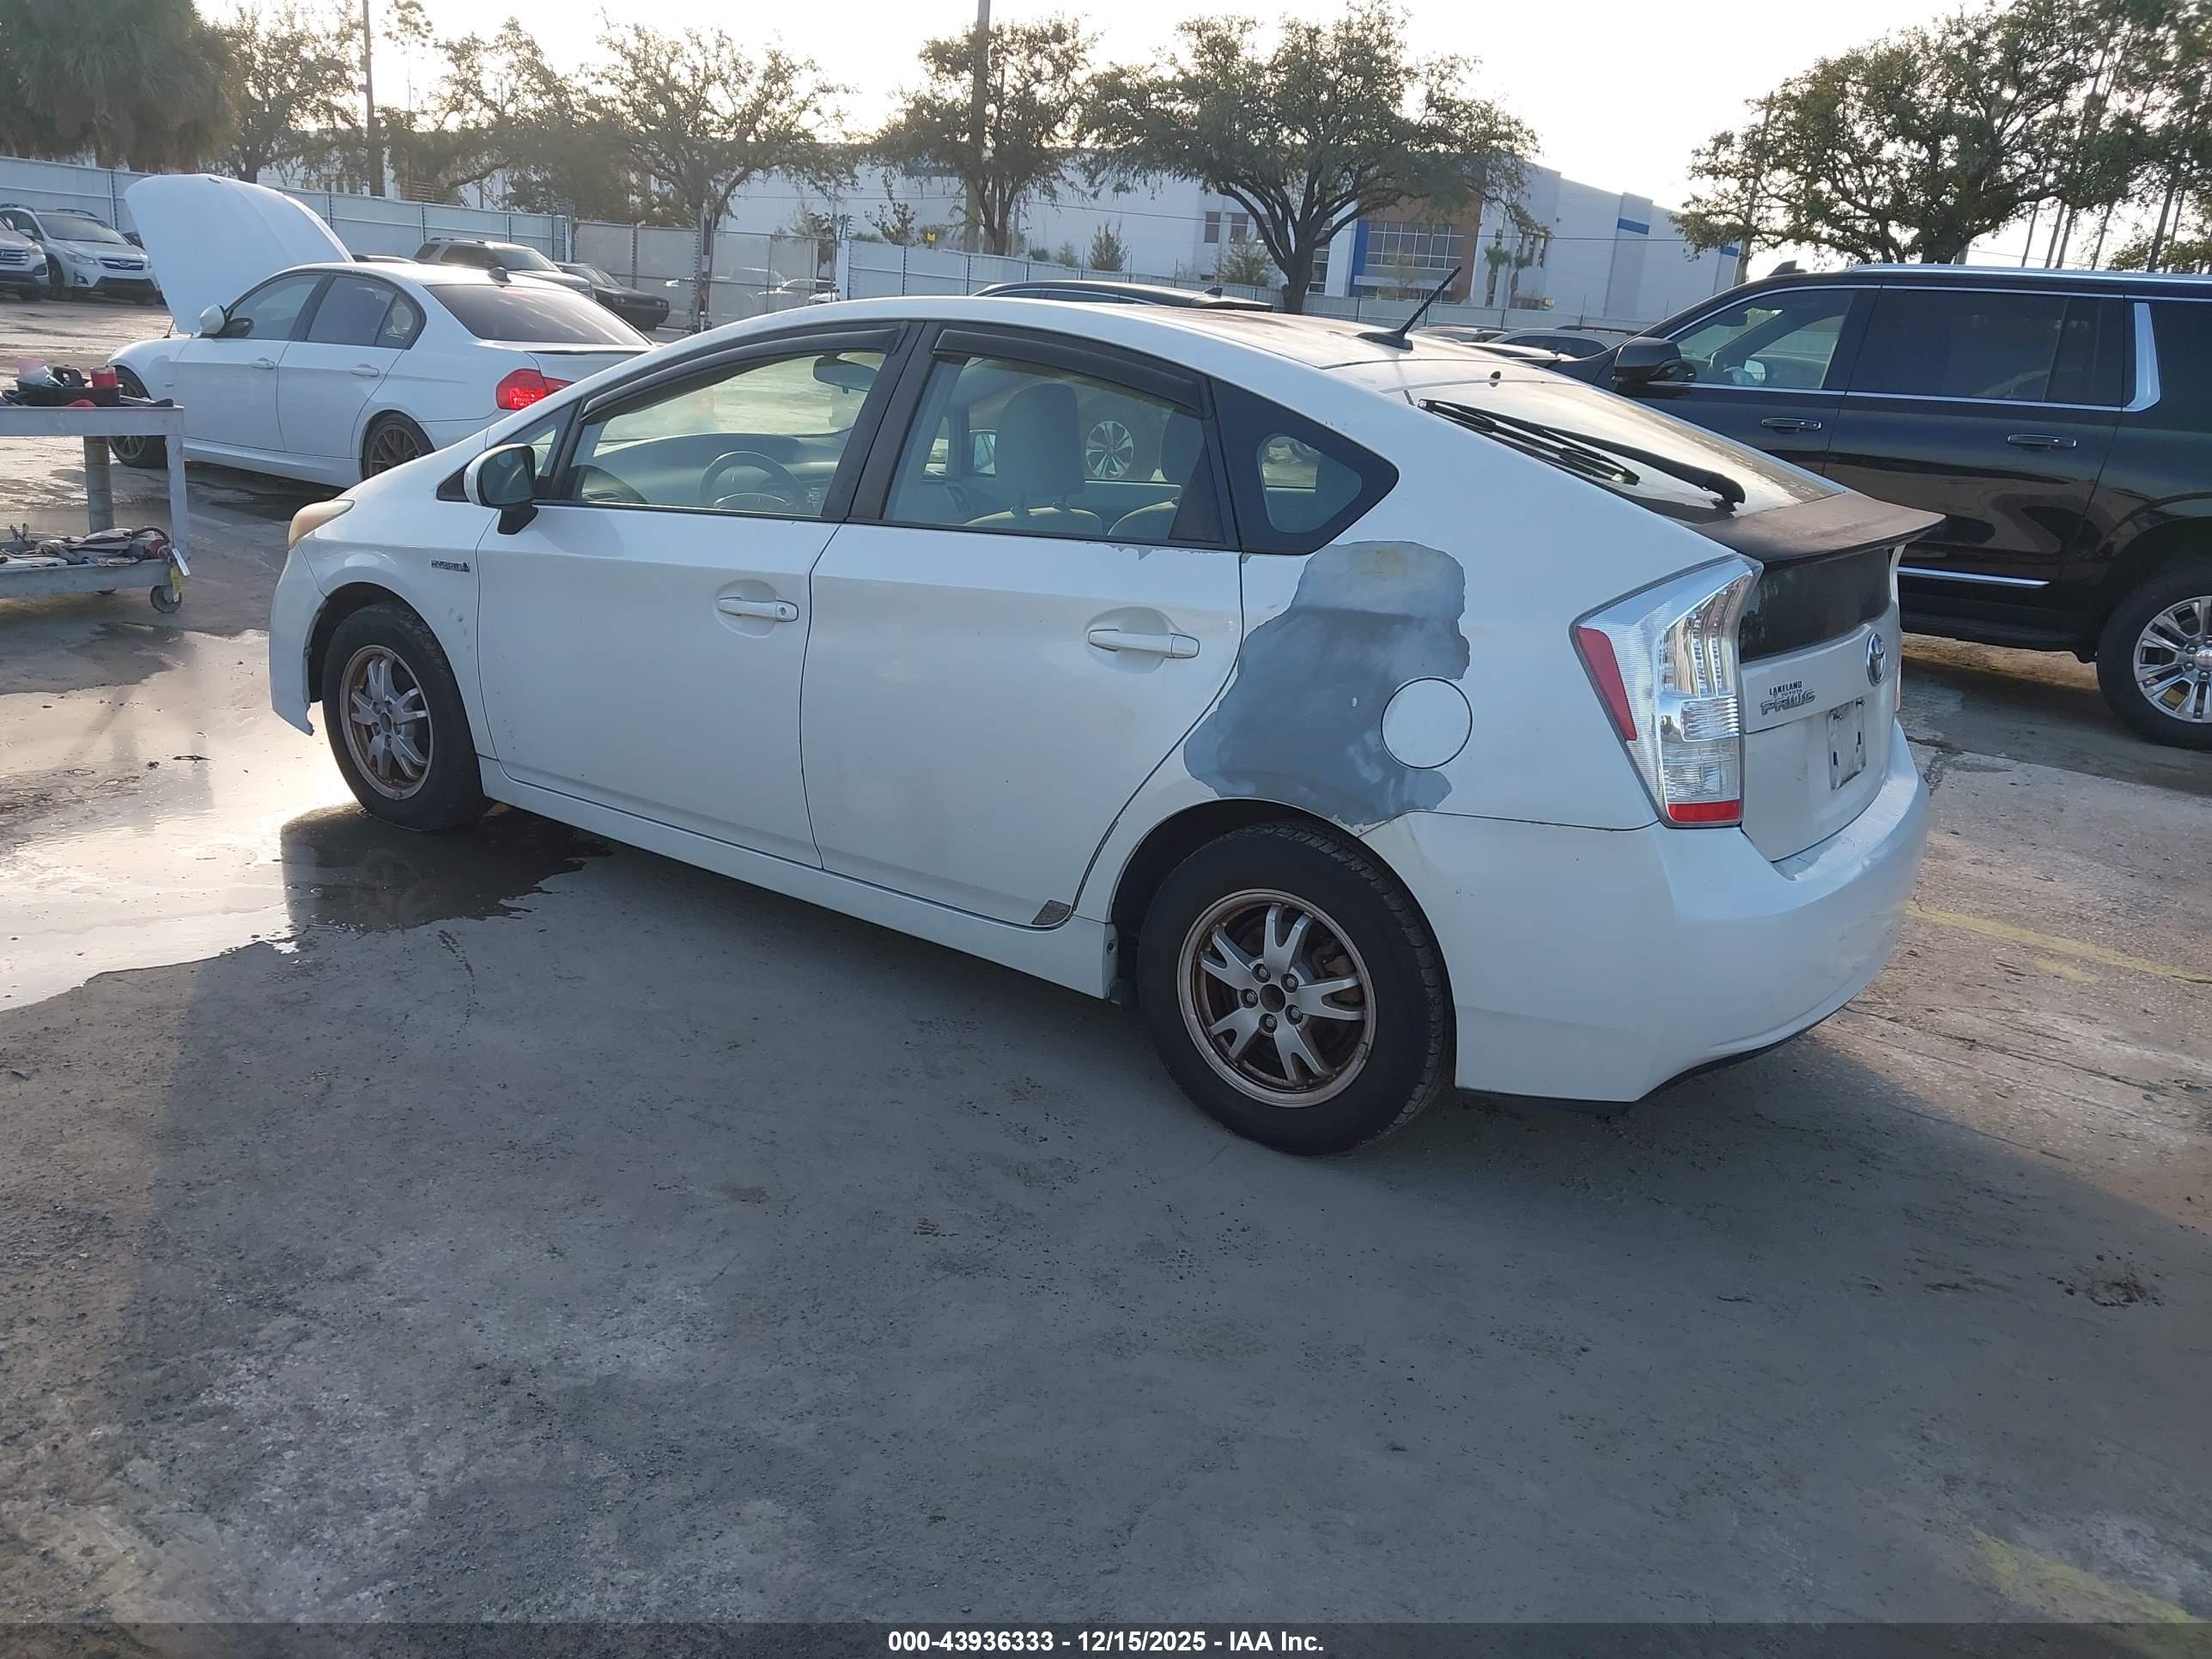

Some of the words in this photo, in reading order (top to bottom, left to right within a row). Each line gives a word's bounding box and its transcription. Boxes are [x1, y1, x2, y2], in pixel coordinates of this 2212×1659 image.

[431, 559, 463, 572] HYBRID
[1769, 680, 1802, 696] LAKELAND
[1781, 689, 1802, 697] TOYOTA
[1760, 689, 1815, 715] PRIUS
